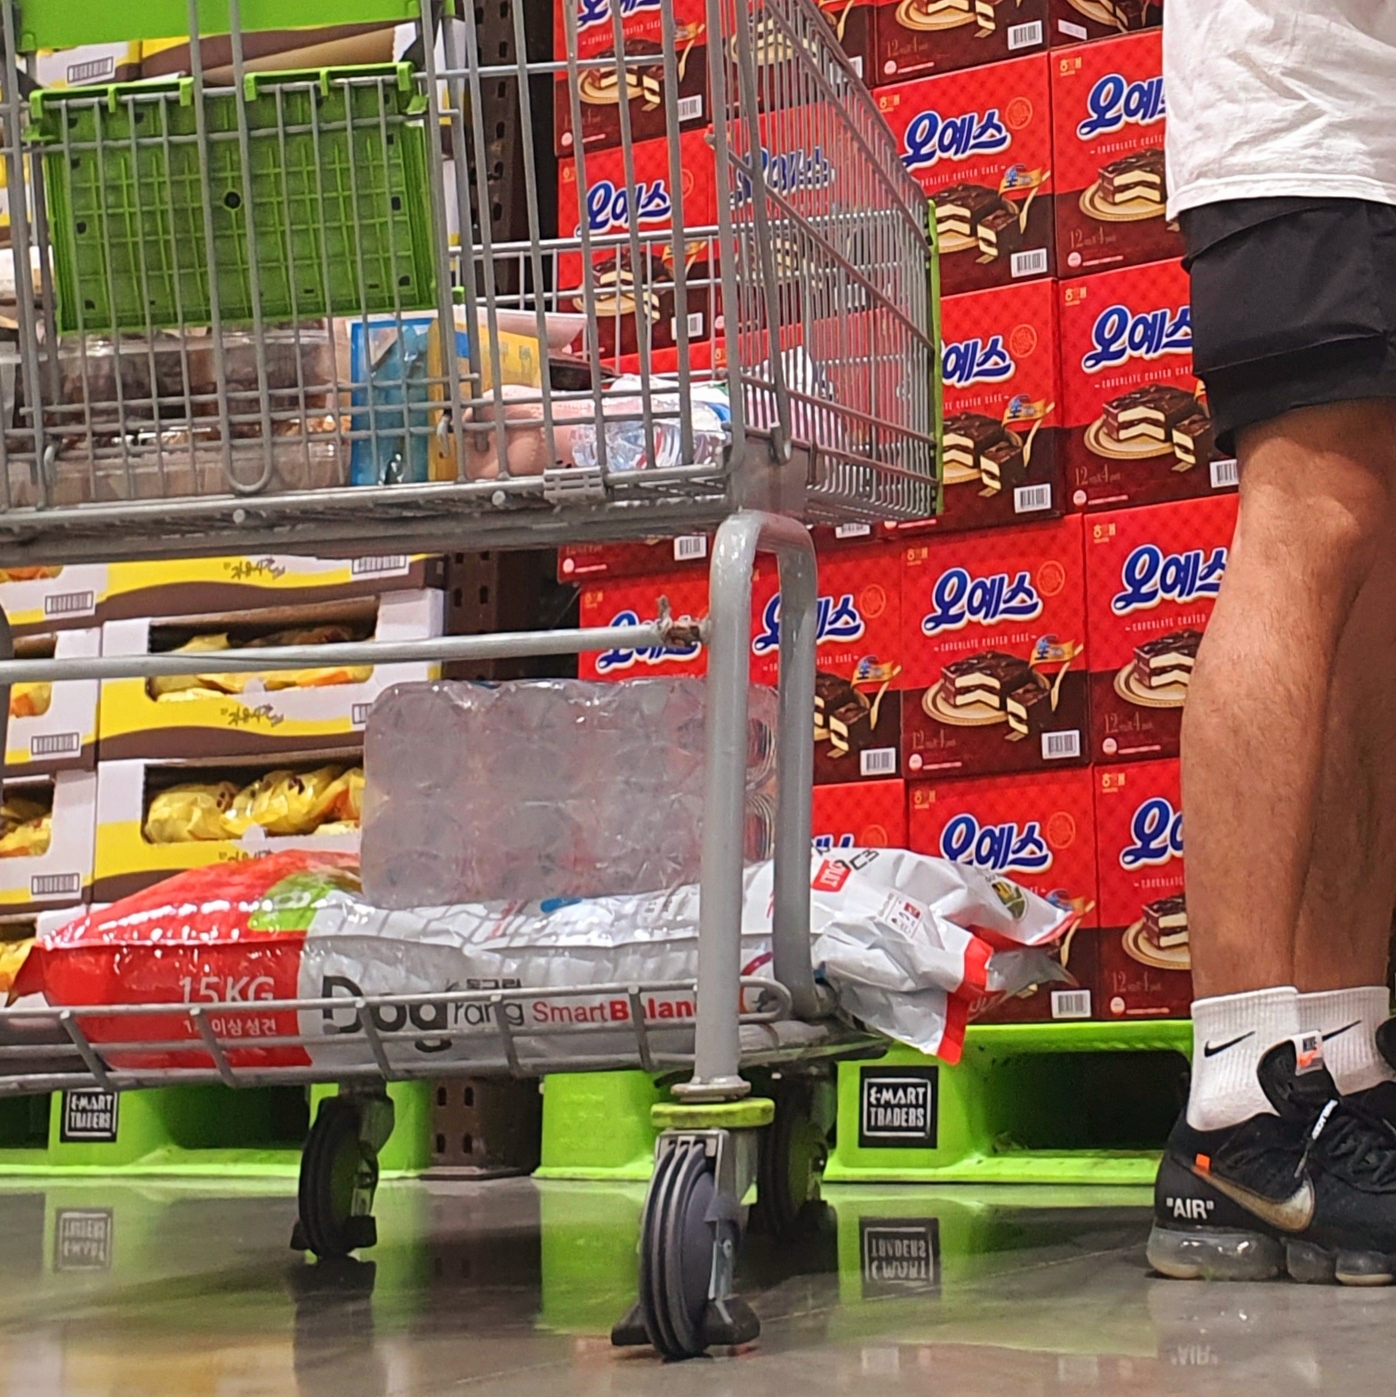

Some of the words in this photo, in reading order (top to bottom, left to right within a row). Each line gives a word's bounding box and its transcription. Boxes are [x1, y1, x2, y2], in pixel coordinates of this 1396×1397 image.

[1077, 73, 1166, 142] 오예
[902, 111, 1010, 171] 오예스
[942, 333, 1012, 387] 예스
[1081, 304, 1192, 373] 오예스
[922, 567, 1043, 636] 오예스
[1111, 544, 1228, 616] 오예스
[939, 813, 1051, 875] 오예스
[179, 975, 275, 1004] 15KG
[869, 1106, 925, 1128] TRADERS
